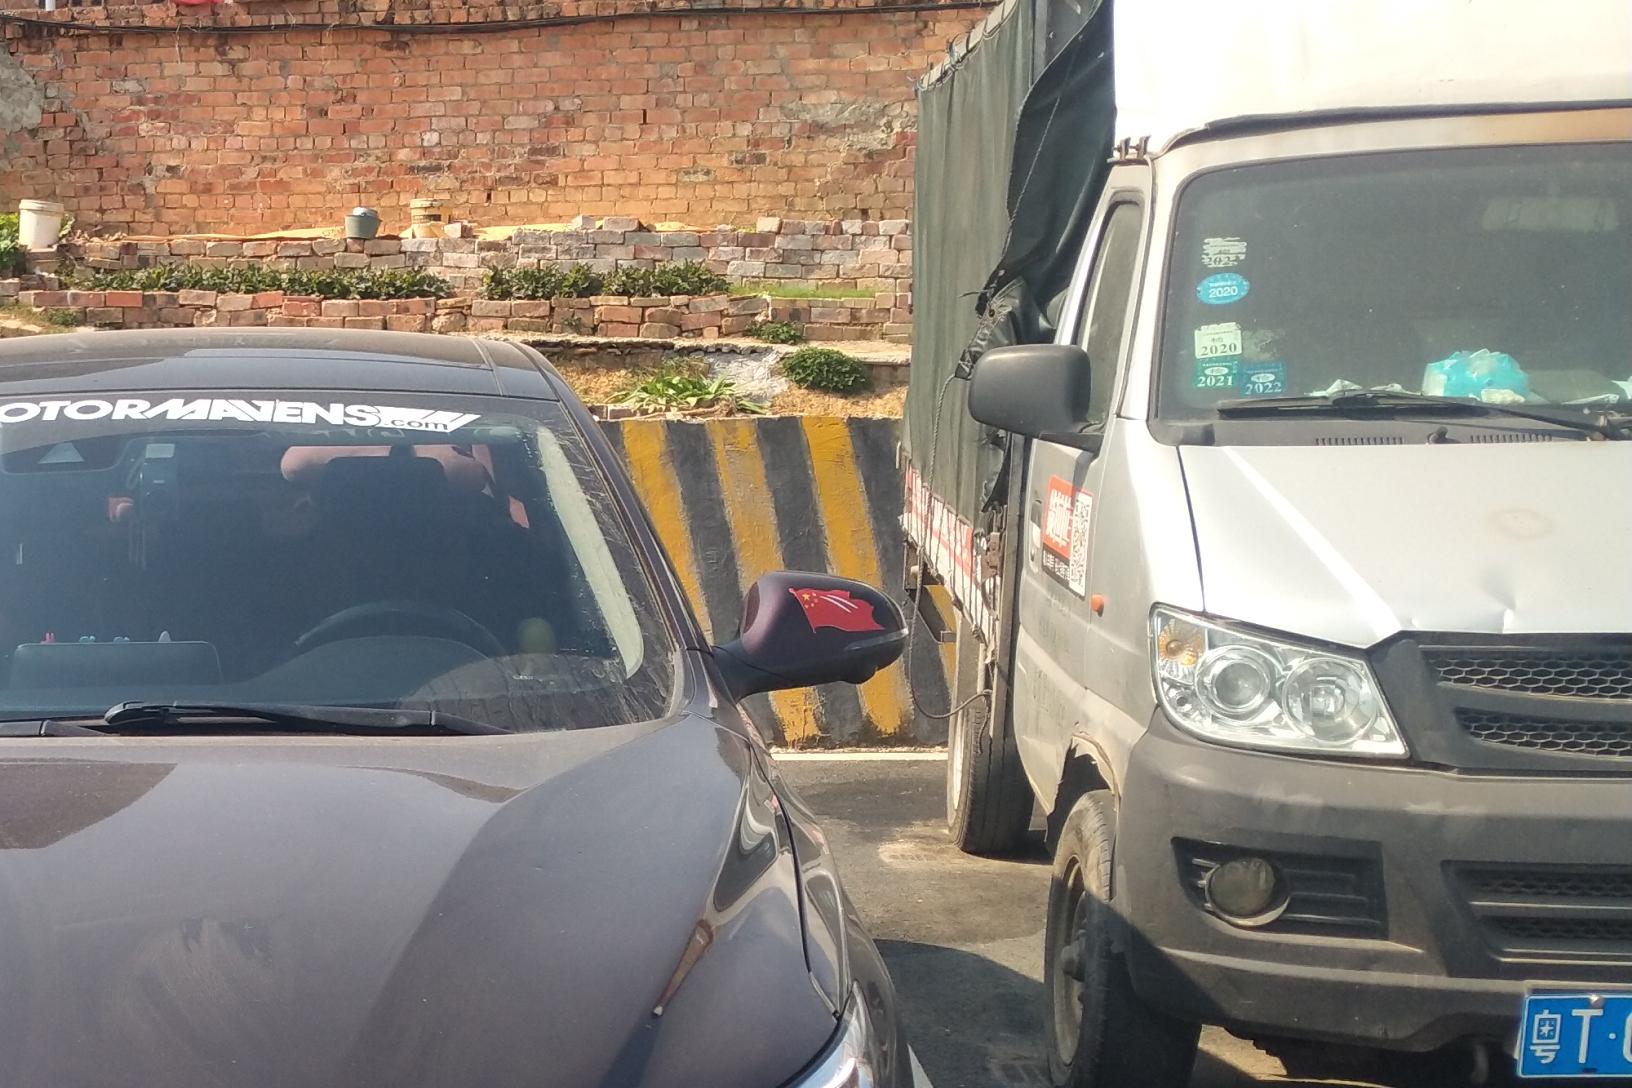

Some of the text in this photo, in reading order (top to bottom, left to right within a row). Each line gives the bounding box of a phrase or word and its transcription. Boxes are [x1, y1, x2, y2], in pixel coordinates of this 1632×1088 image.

[1208, 286, 1238, 298] 2020
[1200, 343, 1237, 356] 2020
[1196, 375, 1233, 387] 2021
[1244, 382, 1282, 395] 2022
